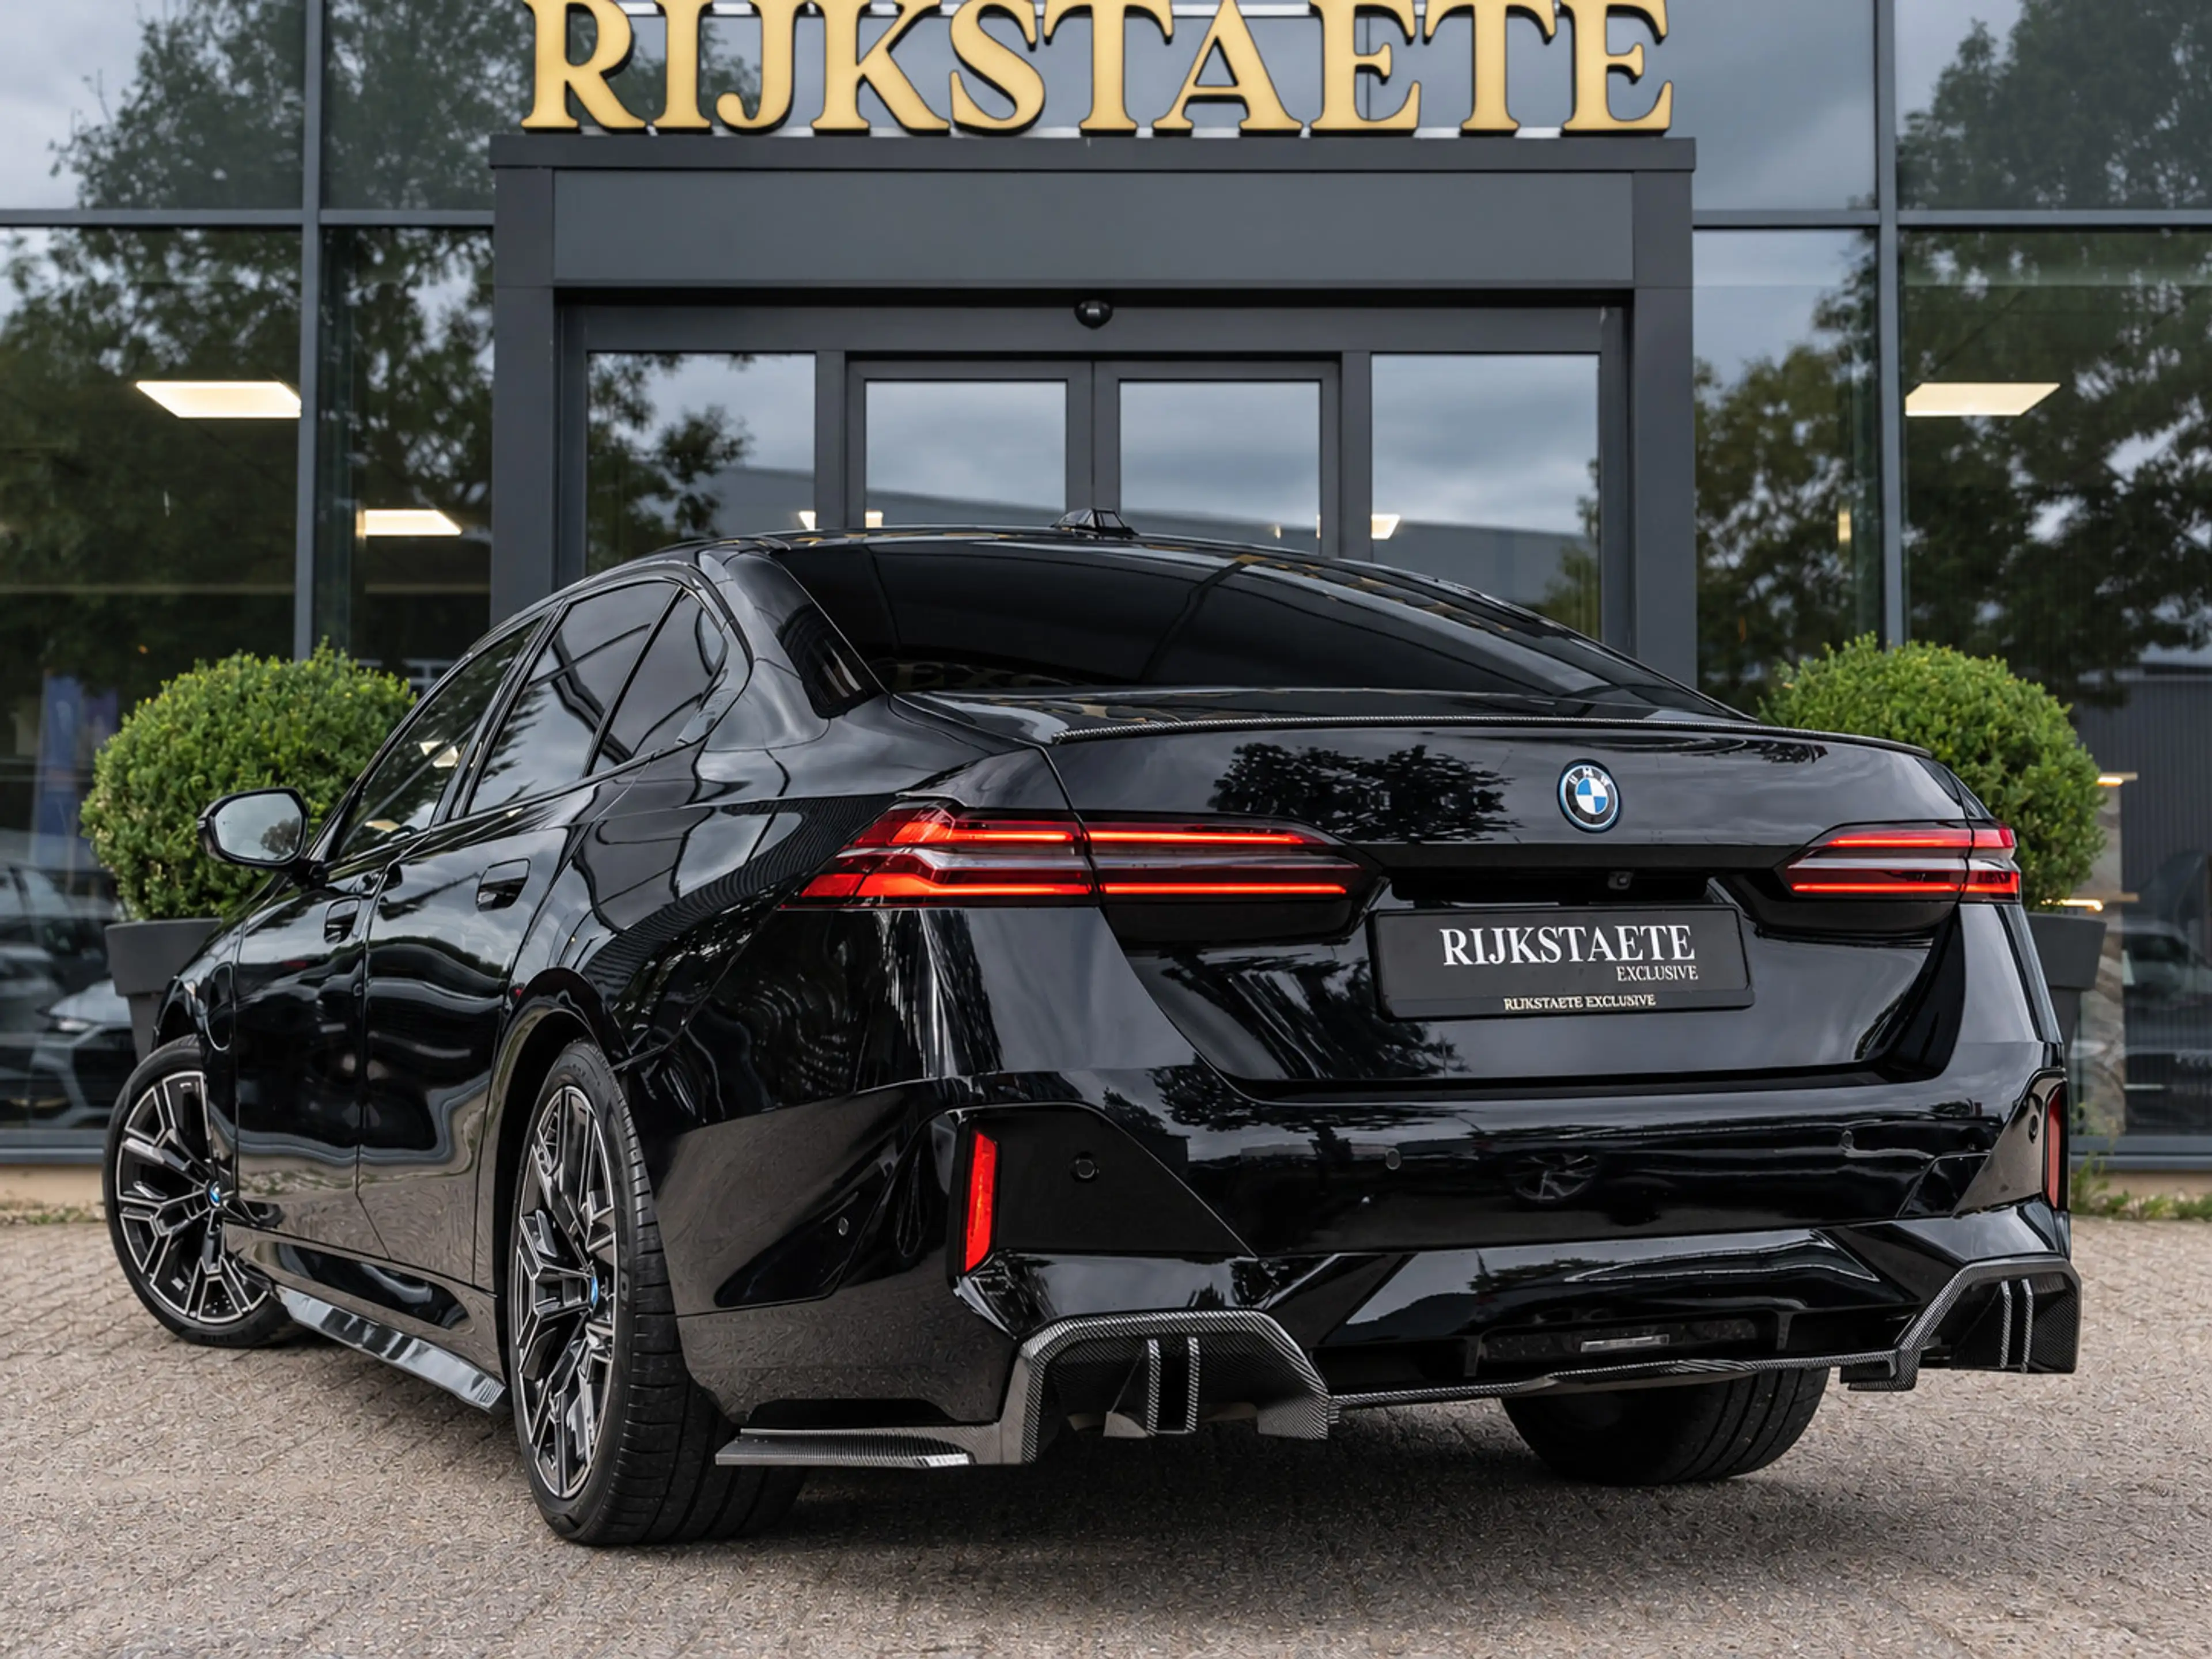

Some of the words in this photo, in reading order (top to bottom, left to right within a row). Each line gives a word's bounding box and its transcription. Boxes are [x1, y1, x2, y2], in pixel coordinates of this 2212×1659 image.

[521, 0, 1672, 136] RIJKSTAETE
[1440, 925, 1696, 966] RIJKSTAETE
[1616, 965, 1698, 982] EXCLUSIVE
[1503, 996, 1584, 1010] RIJKSTAETE
[1585, 994, 1656, 1007] EXCLUSIVE
